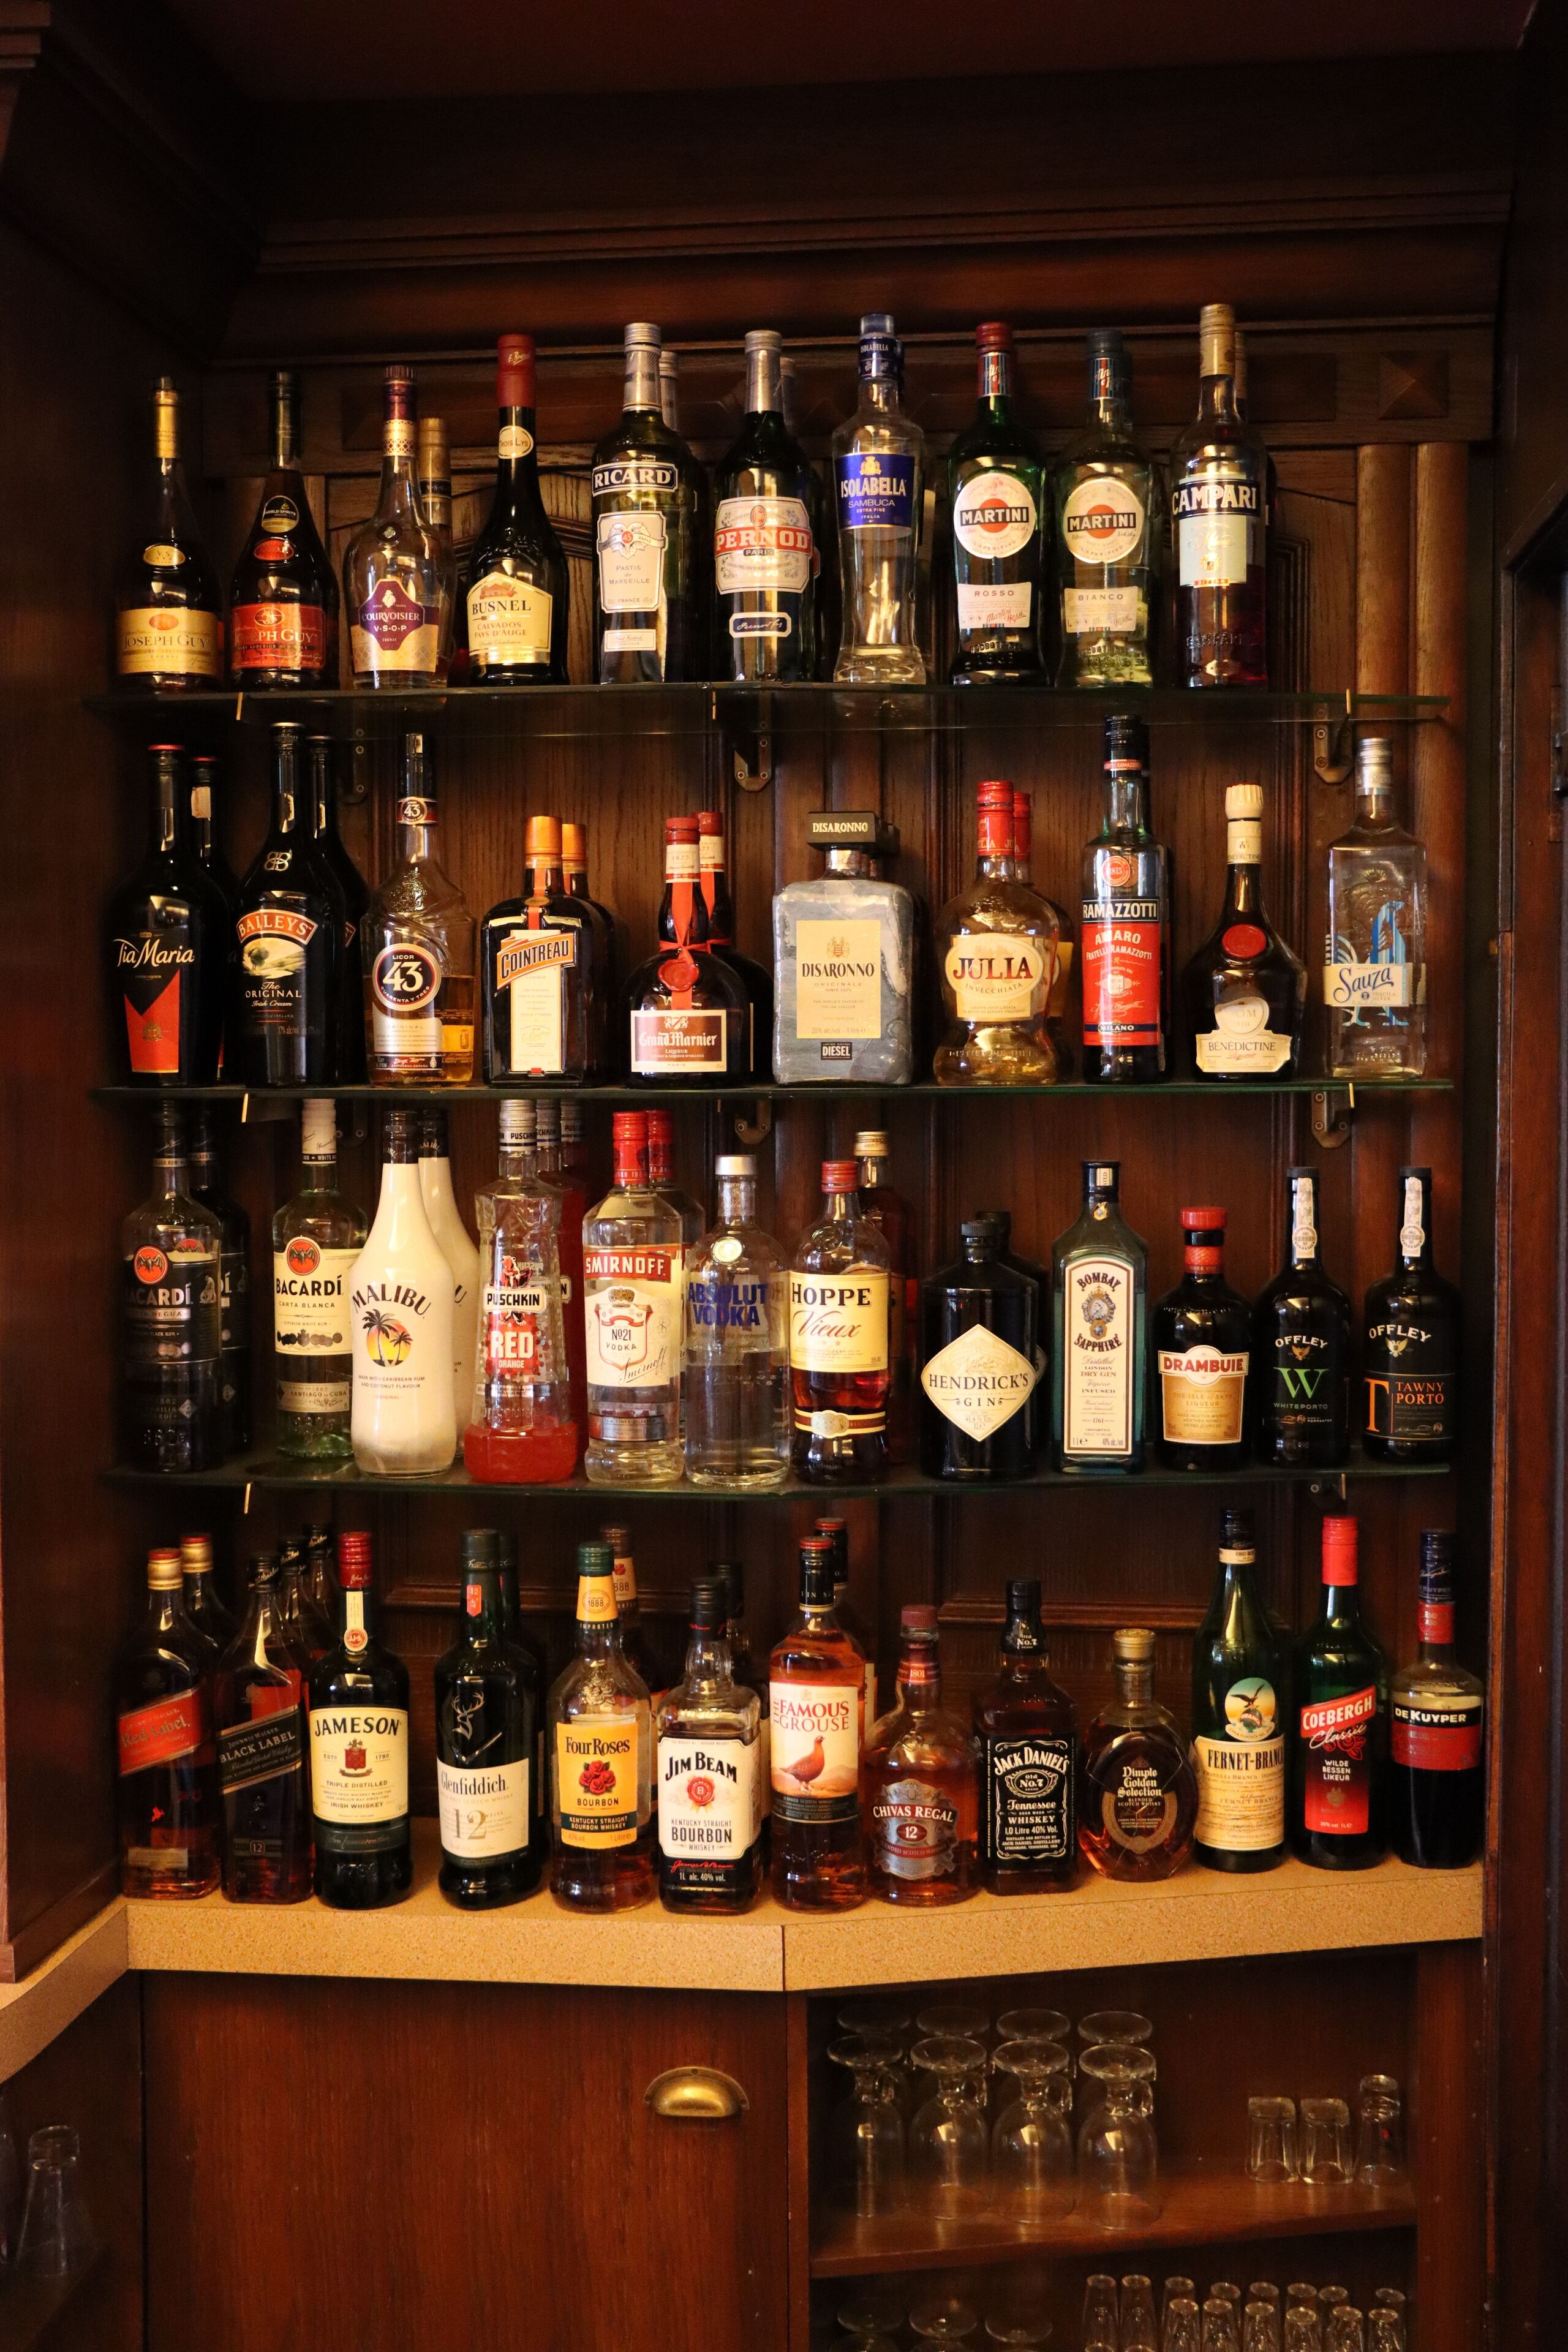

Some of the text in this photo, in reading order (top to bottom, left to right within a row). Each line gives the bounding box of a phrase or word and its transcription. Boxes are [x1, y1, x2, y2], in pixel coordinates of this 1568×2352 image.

[516, 438, 529, 447] LYS
[594, 469, 671, 489] RICARD
[842, 477, 905, 497] ISOLABELLA
[848, 499, 895, 508] SAMBUCA
[1172, 485, 1256, 515] CAMPARI
[962, 508, 1027, 524] MARTINI
[1069, 514, 1135, 531] MARTINI
[622, 533, 632, 543] 45
[716, 529, 809, 551] PERNOD
[472, 600, 532, 615] BUSNEL
[361, 612, 420, 622] COURVOISIER
[477, 622, 522, 631] CALVADOS
[124, 634, 208, 651] JOSEPH GUY
[281, 629, 314, 643] GUY
[404, 803, 421, 817] 43
[812, 821, 869, 834] DISARONNO
[1082, 900, 1157, 919] RAMAZZOTTI
[238, 914, 308, 936] BAILEYS
[1095, 932, 1141, 945] AMARO
[113, 938, 195, 968] Tia Maria
[501, 938, 570, 979] COINTREAU
[1110, 945, 1152, 960] RAMAZZOTTI
[382, 962, 423, 992] 43
[802, 963, 875, 978] DISARONNO
[953, 957, 1033, 981] JULIA
[261, 981, 281, 990] The
[966, 983, 1023, 993] INVECCHIATA
[1333, 967, 1394, 1003] Sauza
[380, 986, 409, 1003] CUARENTA
[415, 986, 430, 999] TRES
[639, 1031, 717, 1047] Grand Marnier
[1208, 1041, 1276, 1052] BÉNÉDICTINE
[822, 1046, 850, 1056] DIESEL
[586, 1257, 666, 1276] SMIRNOFF
[276, 1274, 341, 1297] BACARDÍ
[1076, 1272, 1122, 1292] BOMBAY
[352, 1283, 431, 1316] MALIBU
[487, 1292, 540, 1306] PUSCHKIN
[688, 1283, 768, 1305] ABSOLUT
[792, 1283, 871, 1306] HOPPE
[693, 1305, 760, 1326] VODKA
[793, 1310, 862, 1338] Vieux
[1275, 1335, 1328, 1349] OFFLEY
[1369, 1324, 1432, 1343] OFFLEY
[491, 1331, 534, 1359] RED
[606, 1342, 637, 1351] VODKA
[1073, 1333, 1122, 1352] SAPPHIRE
[499, 1360, 524, 1368] ORANGE
[619, 1346, 668, 1384] Smirnoff
[1082, 1355, 1116, 1365] Distilled
[1164, 1357, 1243, 1372] DRAMBUIE
[929, 1373, 1029, 1390] HENDRICK'S
[1273, 1367, 1329, 1399] W
[1395, 1382, 1444, 1392] TAWNY
[963, 1398, 996, 1407] GIN
[1365, 1378, 1389, 1432] T
[1396, 1393, 1444, 1404] PORTO
[780, 1700, 850, 1717] FAMOUS
[1303, 1695, 1373, 1730] COEBERGH
[1395, 1708, 1466, 1724] DE KUYPER
[315, 1717, 399, 1737] JAMESON
[780, 1716, 850, 1733] GROUSE
[1310, 1723, 1367, 1749] Classic
[219, 1731, 295, 1763] BLACK LABEL
[565, 1736, 630, 1756] Four Roses
[665, 1751, 737, 1784] JIM BEAM
[993, 1747, 1069, 1775] JACK DANIEL'S
[1122, 1766, 1157, 1777] Dimple
[441, 1770, 506, 1795] Glenfiddich
[1123, 1777, 1156, 1787] Golden
[1117, 1787, 1163, 1798] Selection
[577, 1798, 619, 1806] BOURBON
[1007, 1800, 1056, 1811] Tennessee
[600, 1815, 627, 1824] STRAIGHT
[873, 1806, 954, 1823] CHIVAS REGAL
[1008, 1815, 1055, 1824] WHISKEY
[453, 1808, 487, 1840] 12
[905, 1826, 918, 1839] 12
[671, 1828, 732, 1842] BOURBON
[701, 1872, 714, 1881] 40%
